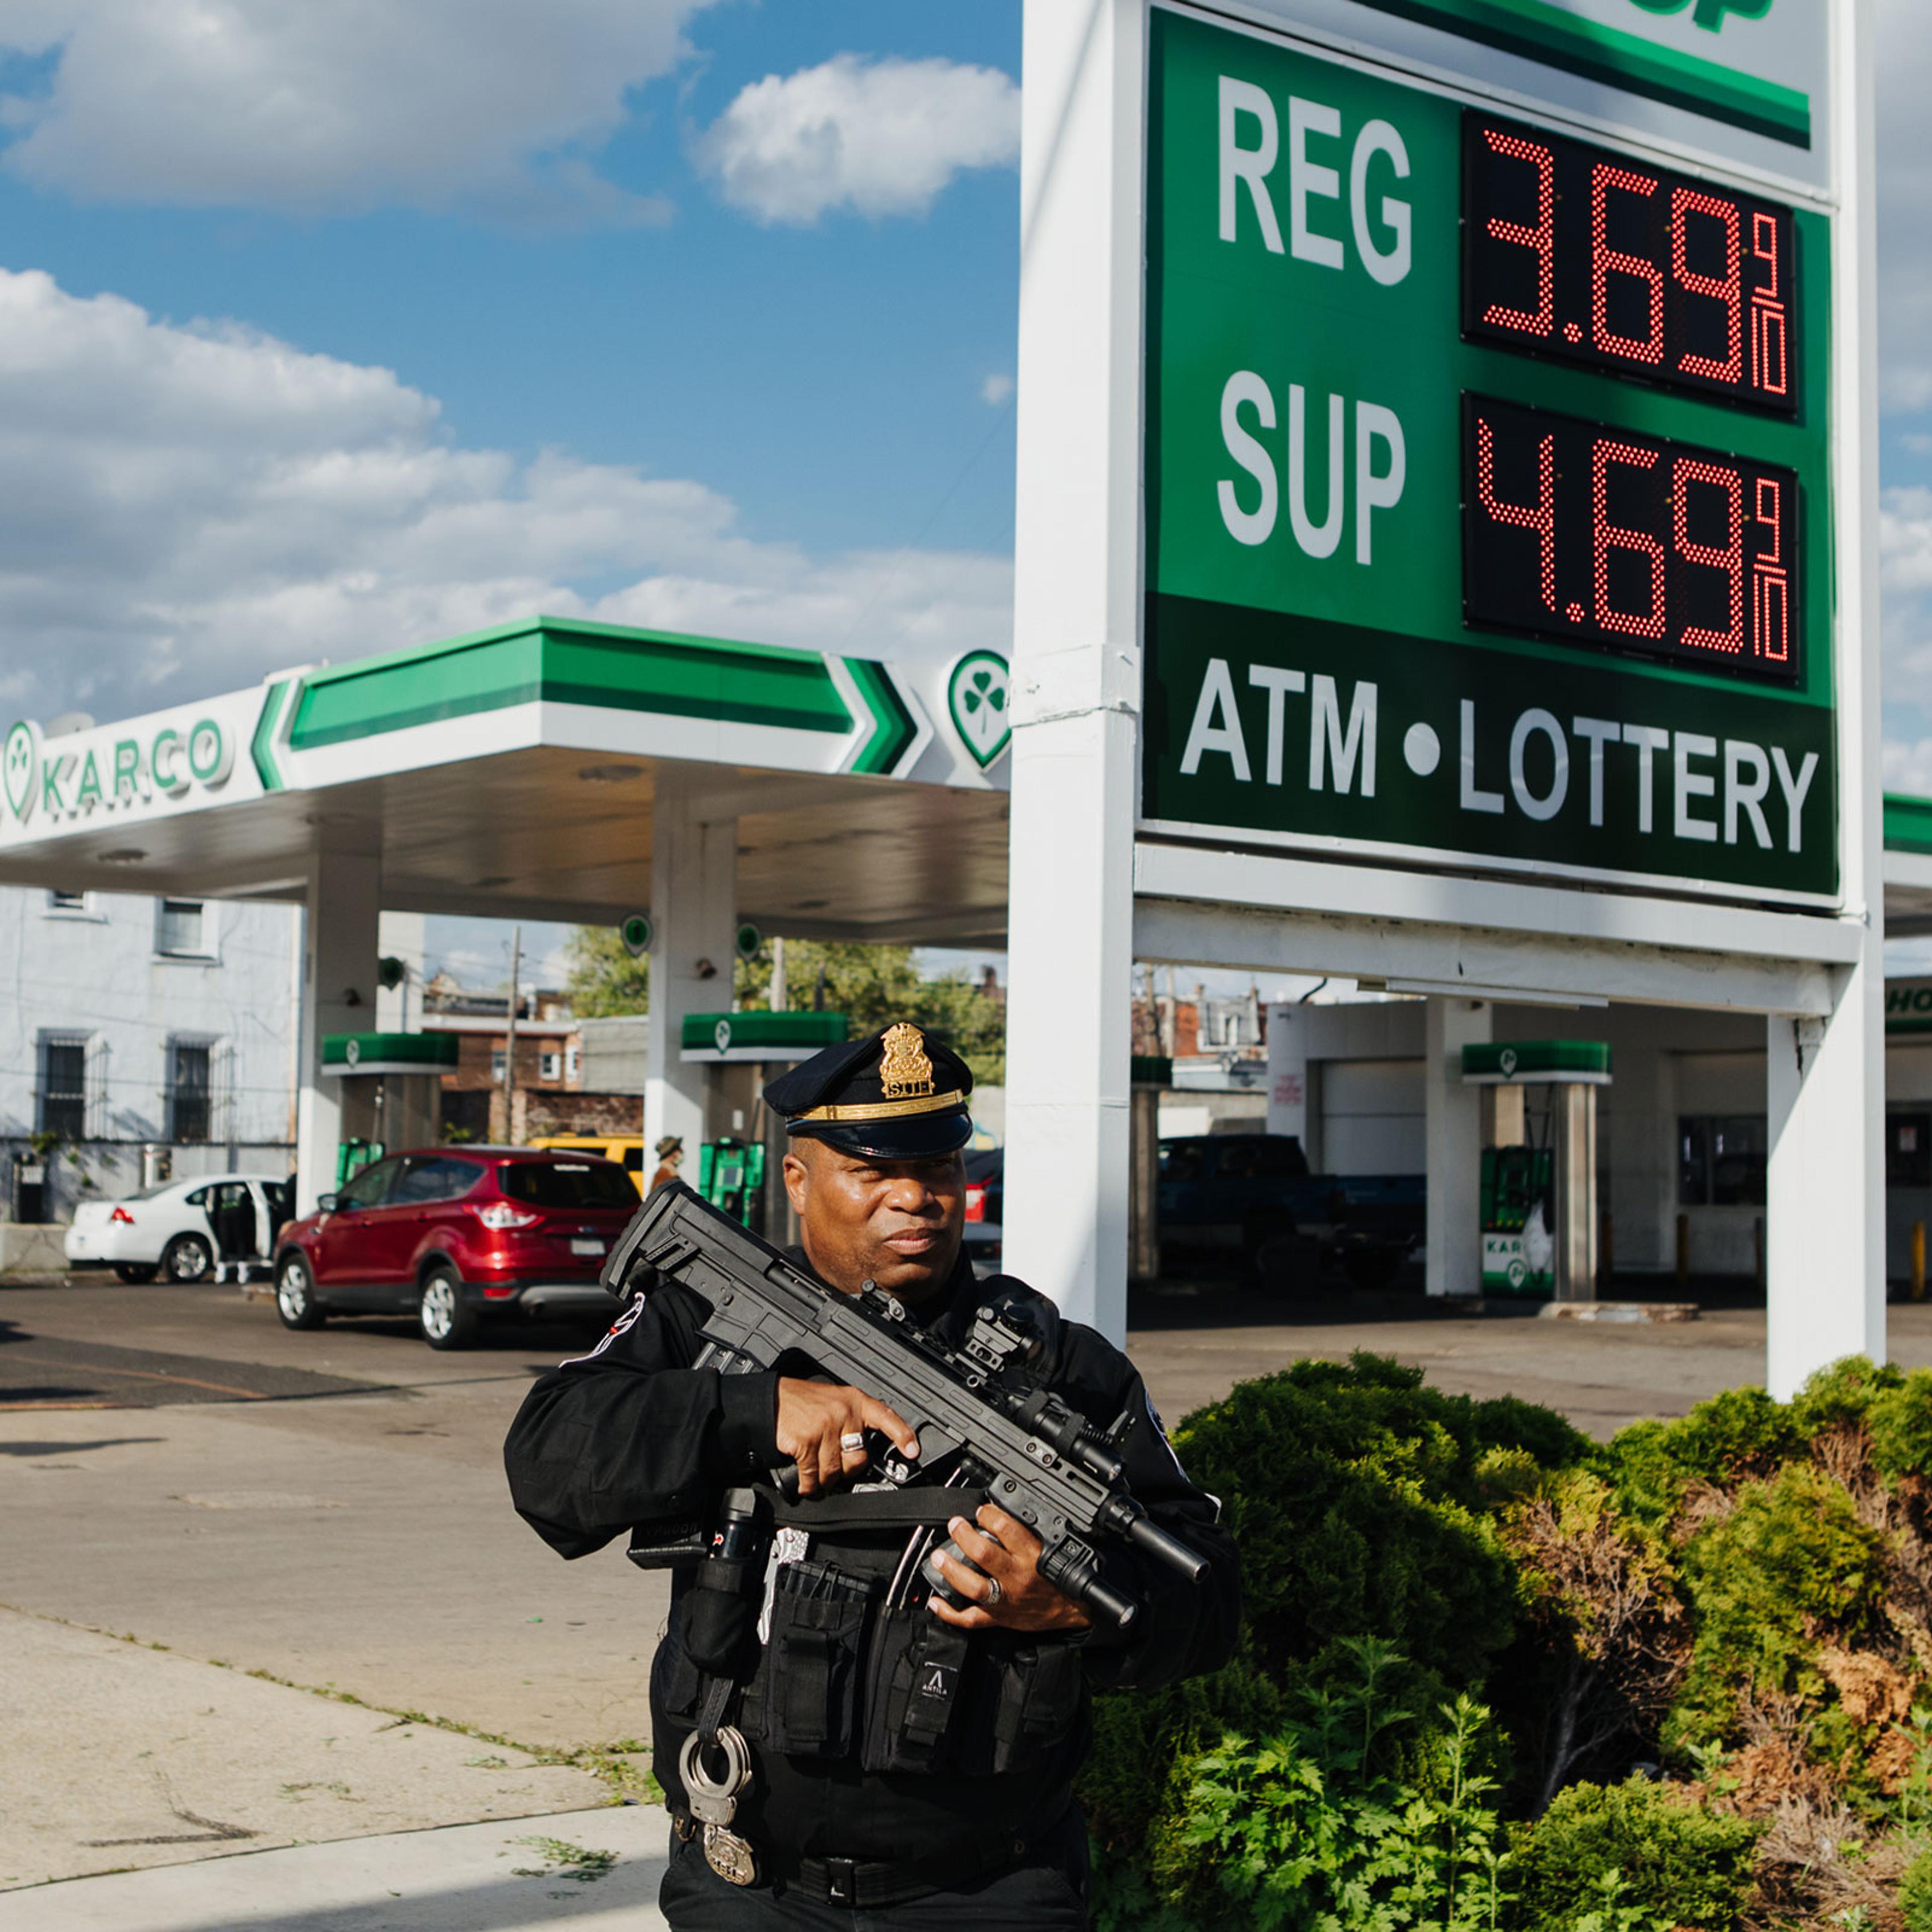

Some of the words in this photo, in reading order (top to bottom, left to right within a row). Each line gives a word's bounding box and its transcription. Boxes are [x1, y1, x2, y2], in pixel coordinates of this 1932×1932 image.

[1219, 74, 1412, 287] REG
[1484, 129, 1742, 383] 3.69
[1217, 370, 1406, 565] SUP
[1478, 418, 1744, 654] 4.69
[43, 719, 223, 812] KARCO
[1179, 657, 1378, 797] ATM
[1460, 698, 1819, 853] LOTTERY
